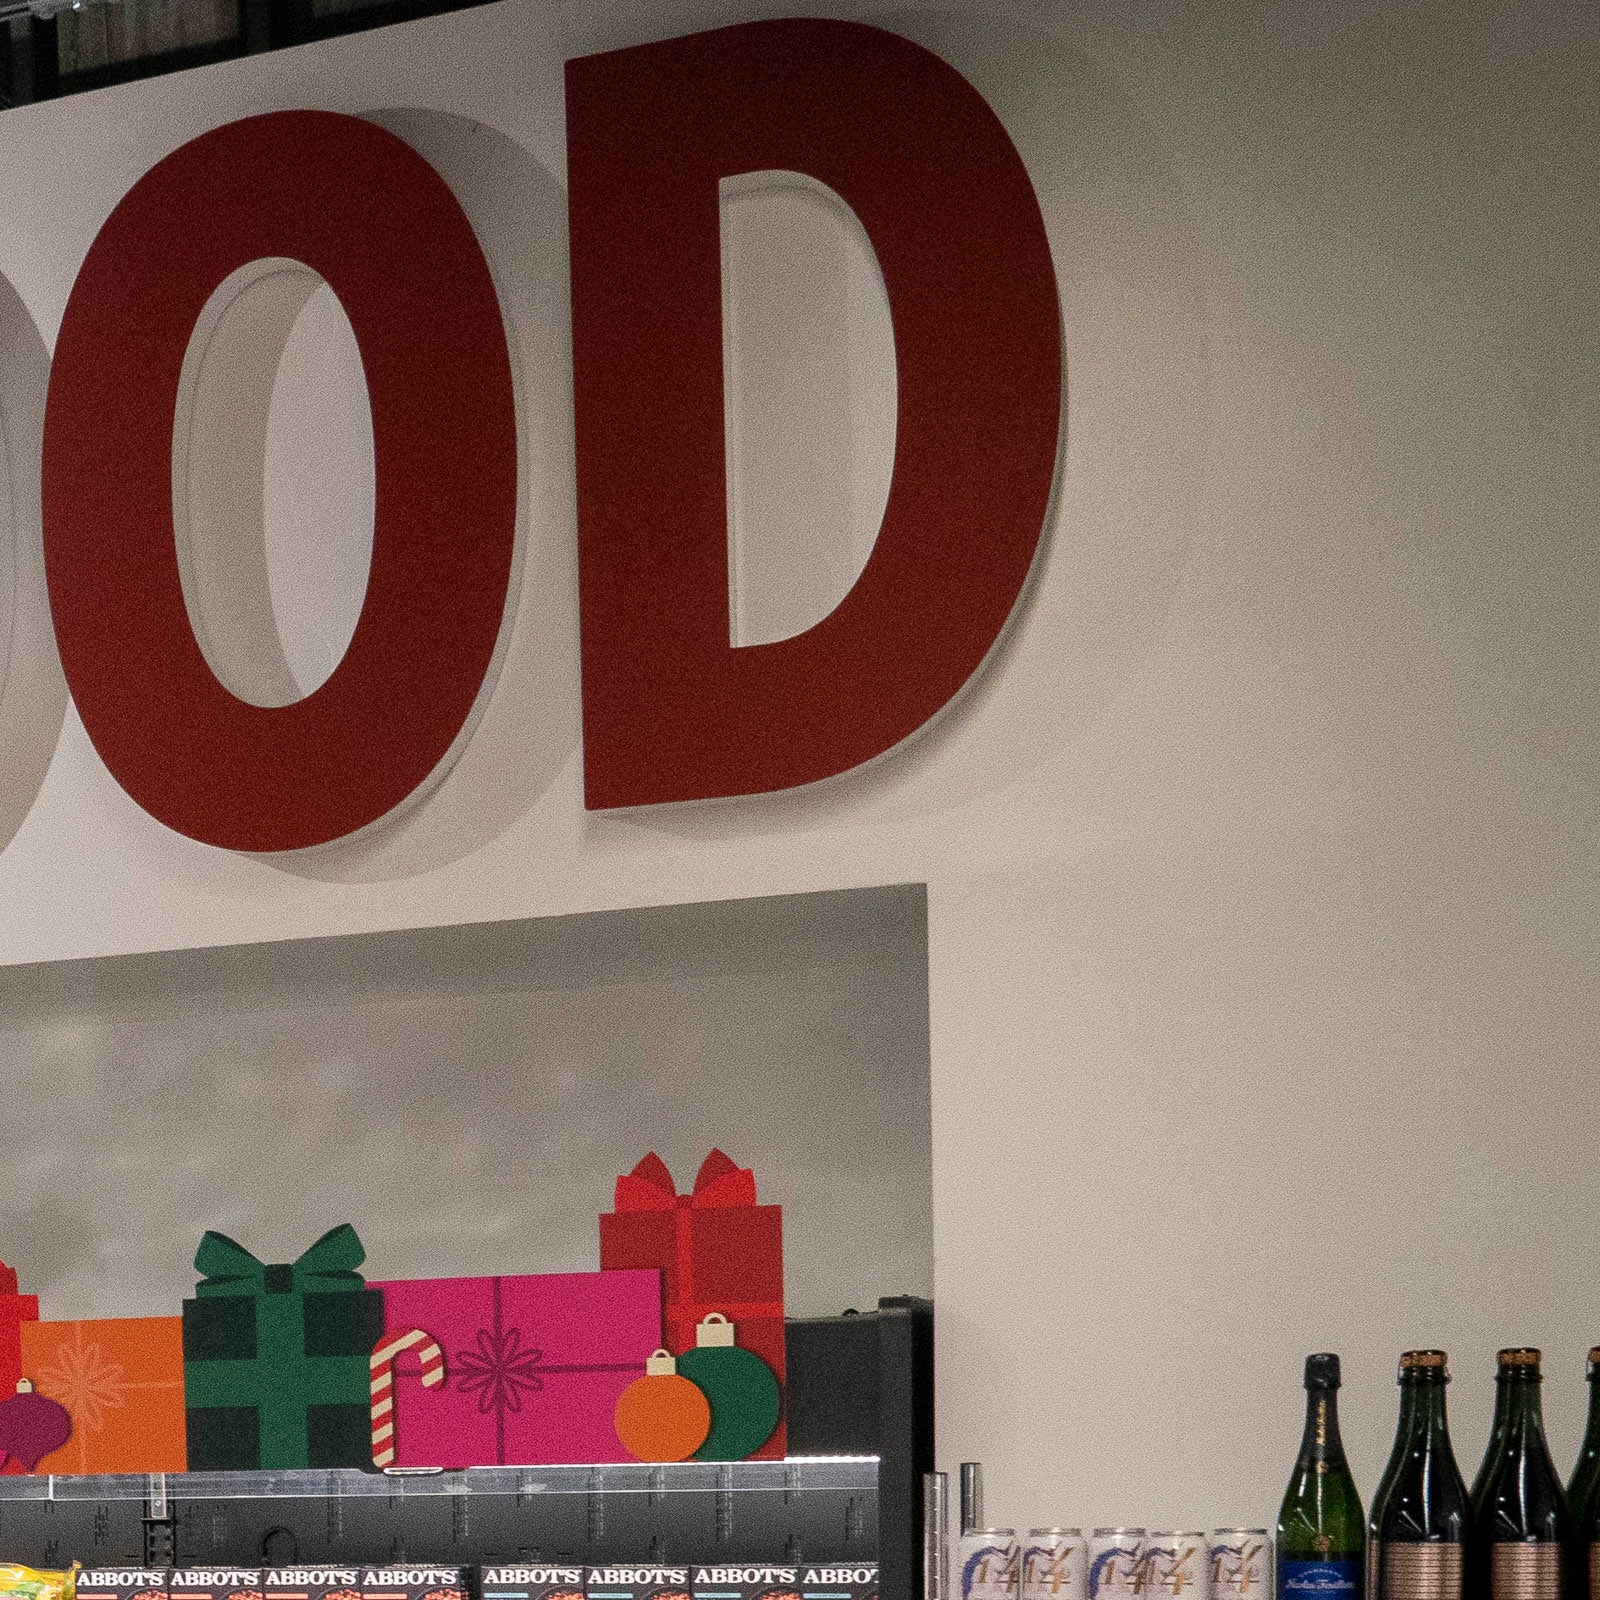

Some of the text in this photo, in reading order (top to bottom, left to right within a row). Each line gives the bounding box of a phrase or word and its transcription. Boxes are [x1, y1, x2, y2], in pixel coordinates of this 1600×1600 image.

[77, 1571, 165, 1586] ABBOT'S
[171, 1571, 260, 1586] ABBOT'S
[266, 1570, 358, 1586] ABBOT'S
[363, 1570, 457, 1585] ABBOT'S
[484, 1569, 581, 1584] ABBOT'S
[588, 1569, 687, 1584] ABBOT'S
[694, 1568, 798, 1583] ABBOT'S
[803, 1568, 879, 1584] ABBO
